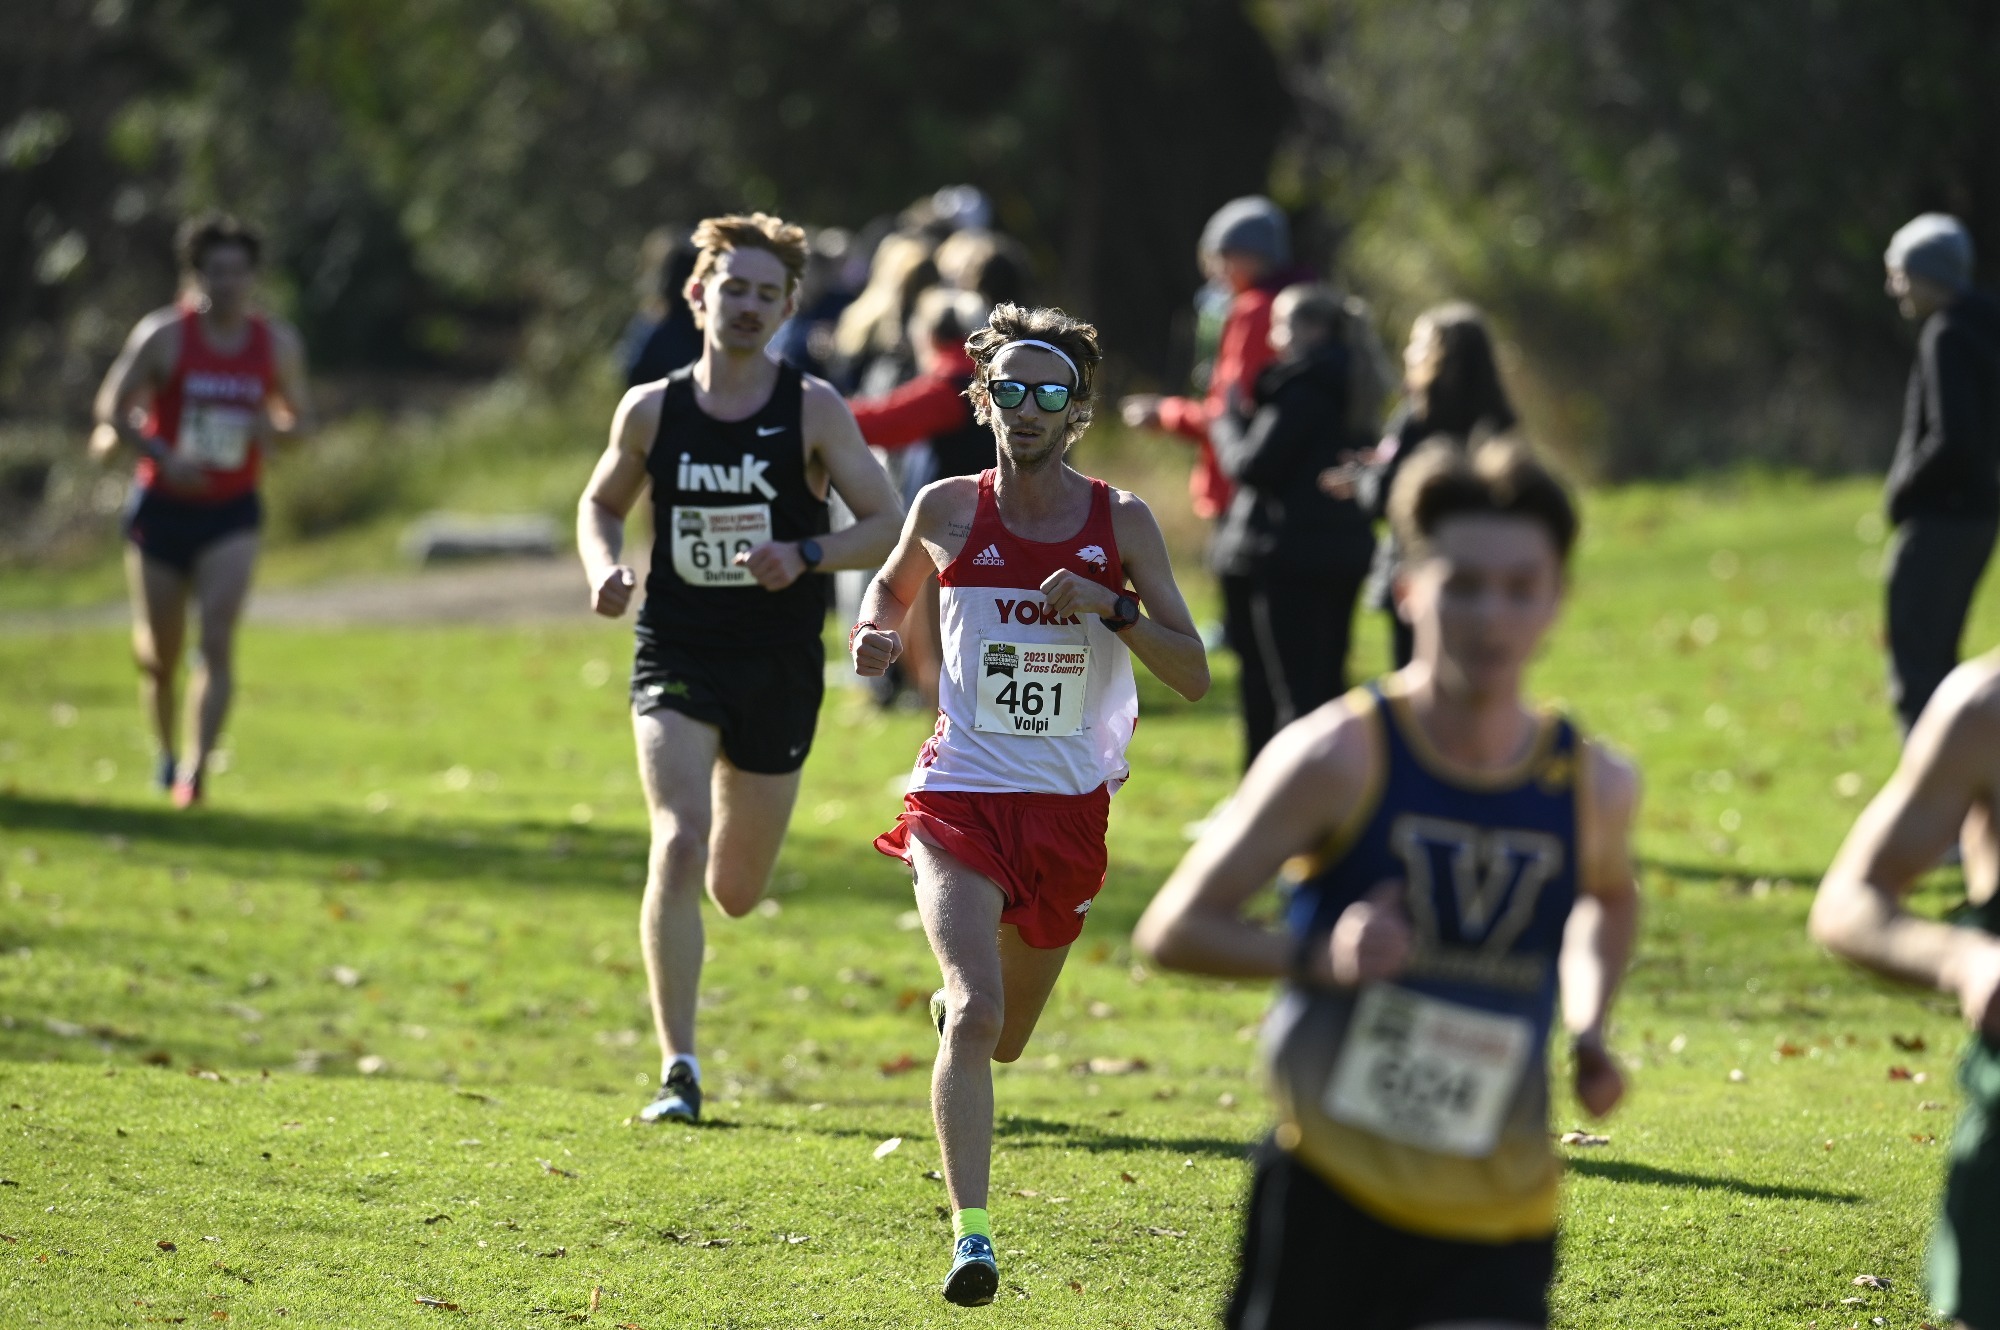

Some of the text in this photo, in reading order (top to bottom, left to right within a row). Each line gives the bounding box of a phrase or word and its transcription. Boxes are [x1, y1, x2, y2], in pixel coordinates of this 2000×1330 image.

[972, 553, 1005, 566] adidas
[1023, 651, 1046, 663] 2023
[1047, 652, 1054, 663] U
[1054, 653, 1085, 664] SPORTS
[1023, 663, 1050, 673] Cross
[1050, 663, 1085, 676] Country
[995, 680, 1063, 716] 461
[1014, 715, 1049, 734] Volpi
